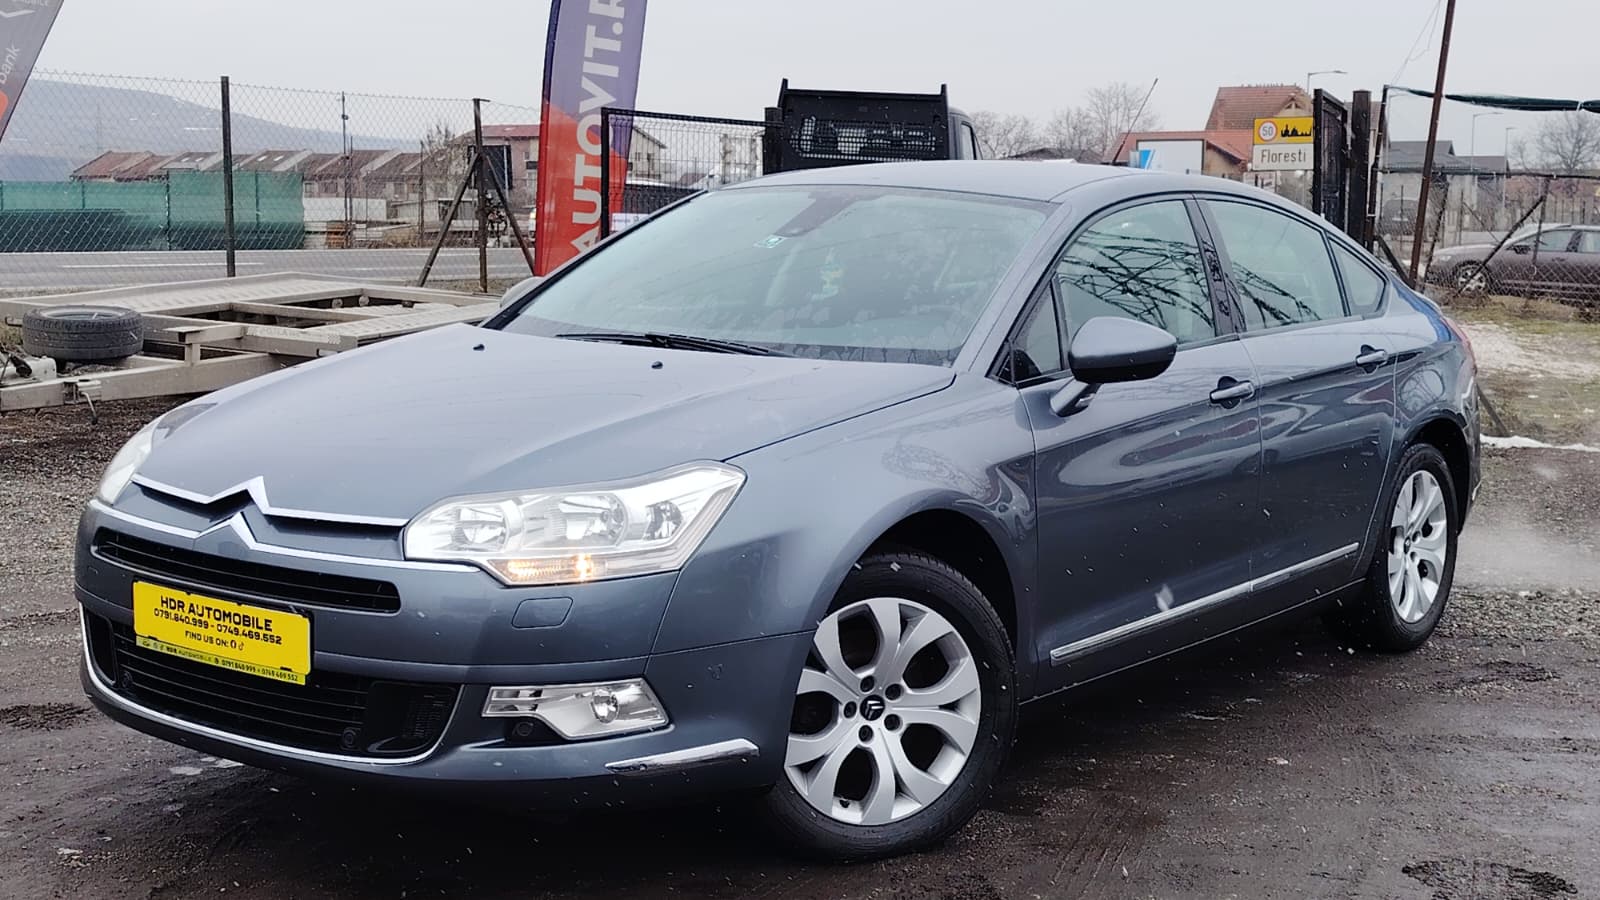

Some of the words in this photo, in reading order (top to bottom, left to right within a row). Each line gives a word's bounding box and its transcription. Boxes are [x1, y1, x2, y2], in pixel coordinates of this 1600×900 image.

[1262, 126, 1274, 137] 50
[1261, 149, 1306, 164] Floresti
[160, 595, 185, 612] HDR
[188, 602, 273, 632] AUTOMOBILE
[154, 608, 209, 629] 0791.840.999
[217, 623, 282, 645] 0749.469.552
[185, 630, 202, 641] FIND
[203, 634, 214, 644] US
